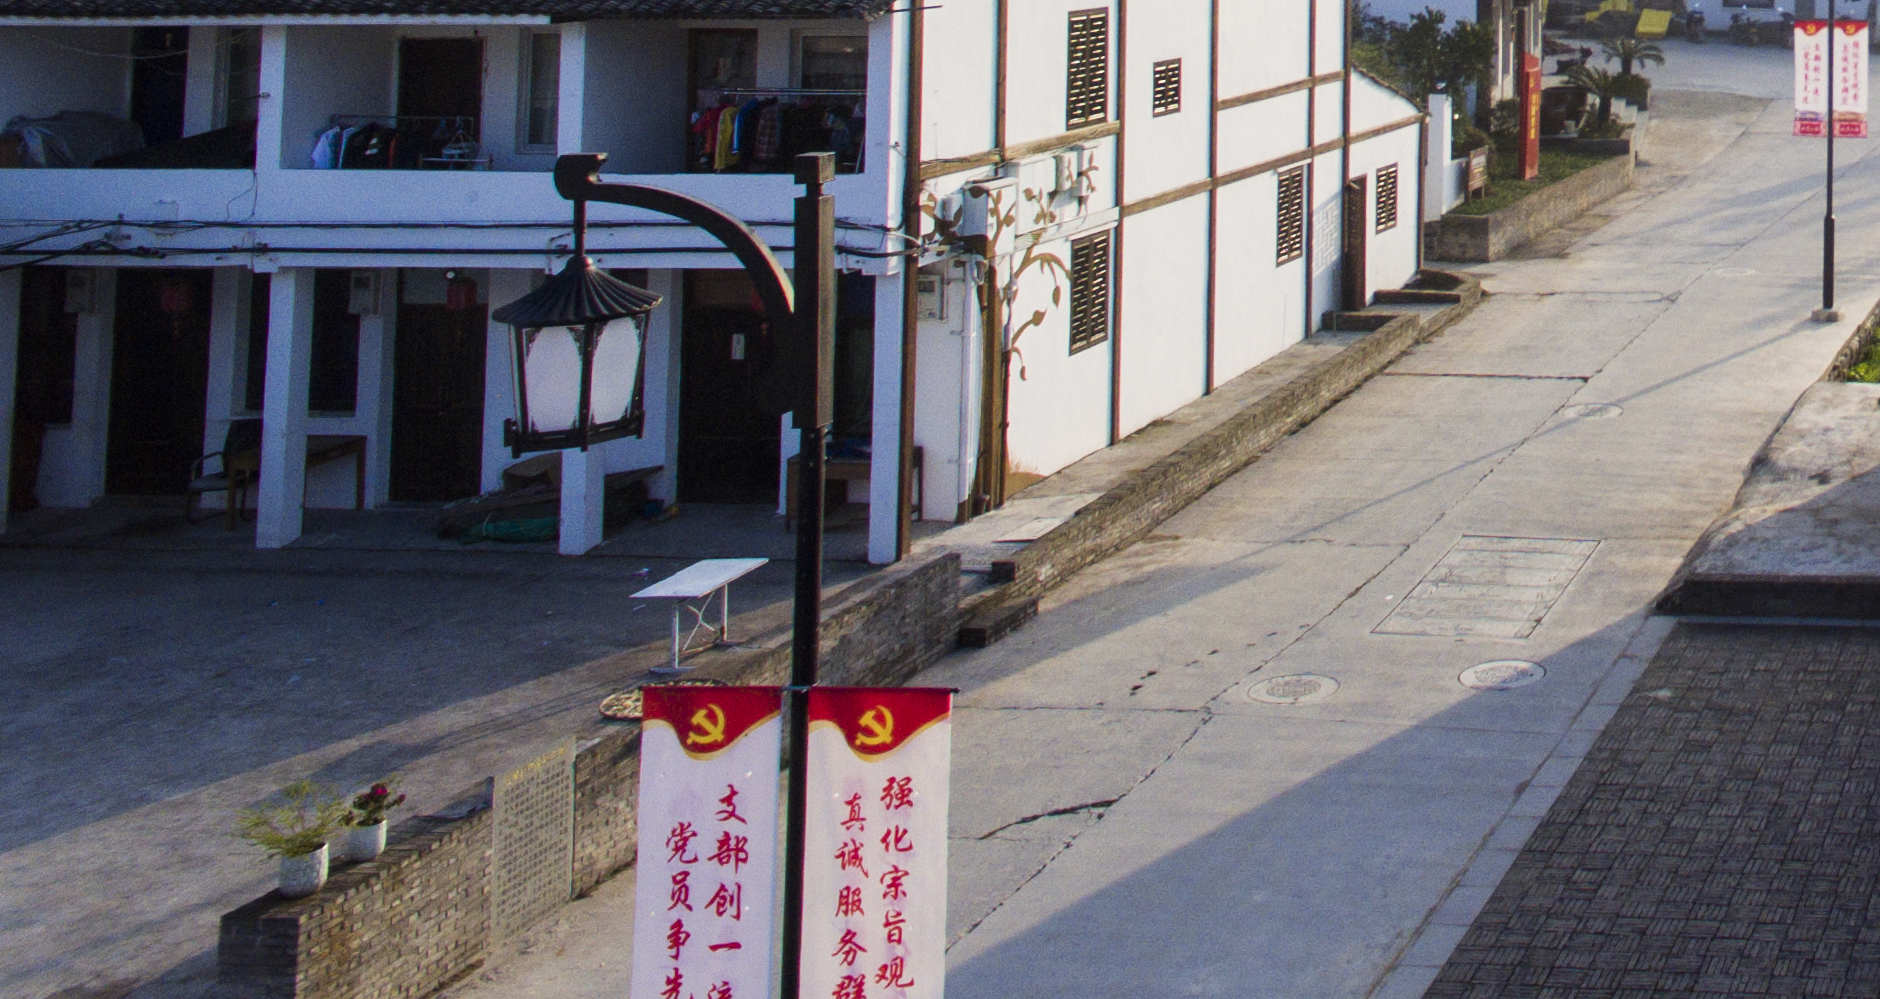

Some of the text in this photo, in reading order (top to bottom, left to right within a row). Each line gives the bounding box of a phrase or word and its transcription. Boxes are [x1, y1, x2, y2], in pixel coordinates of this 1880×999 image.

[660, 822, 700, 999] 党员争先
[831, 792, 870, 999] 真诚服务群
[874, 776, 915, 990] 强化宗旨观
